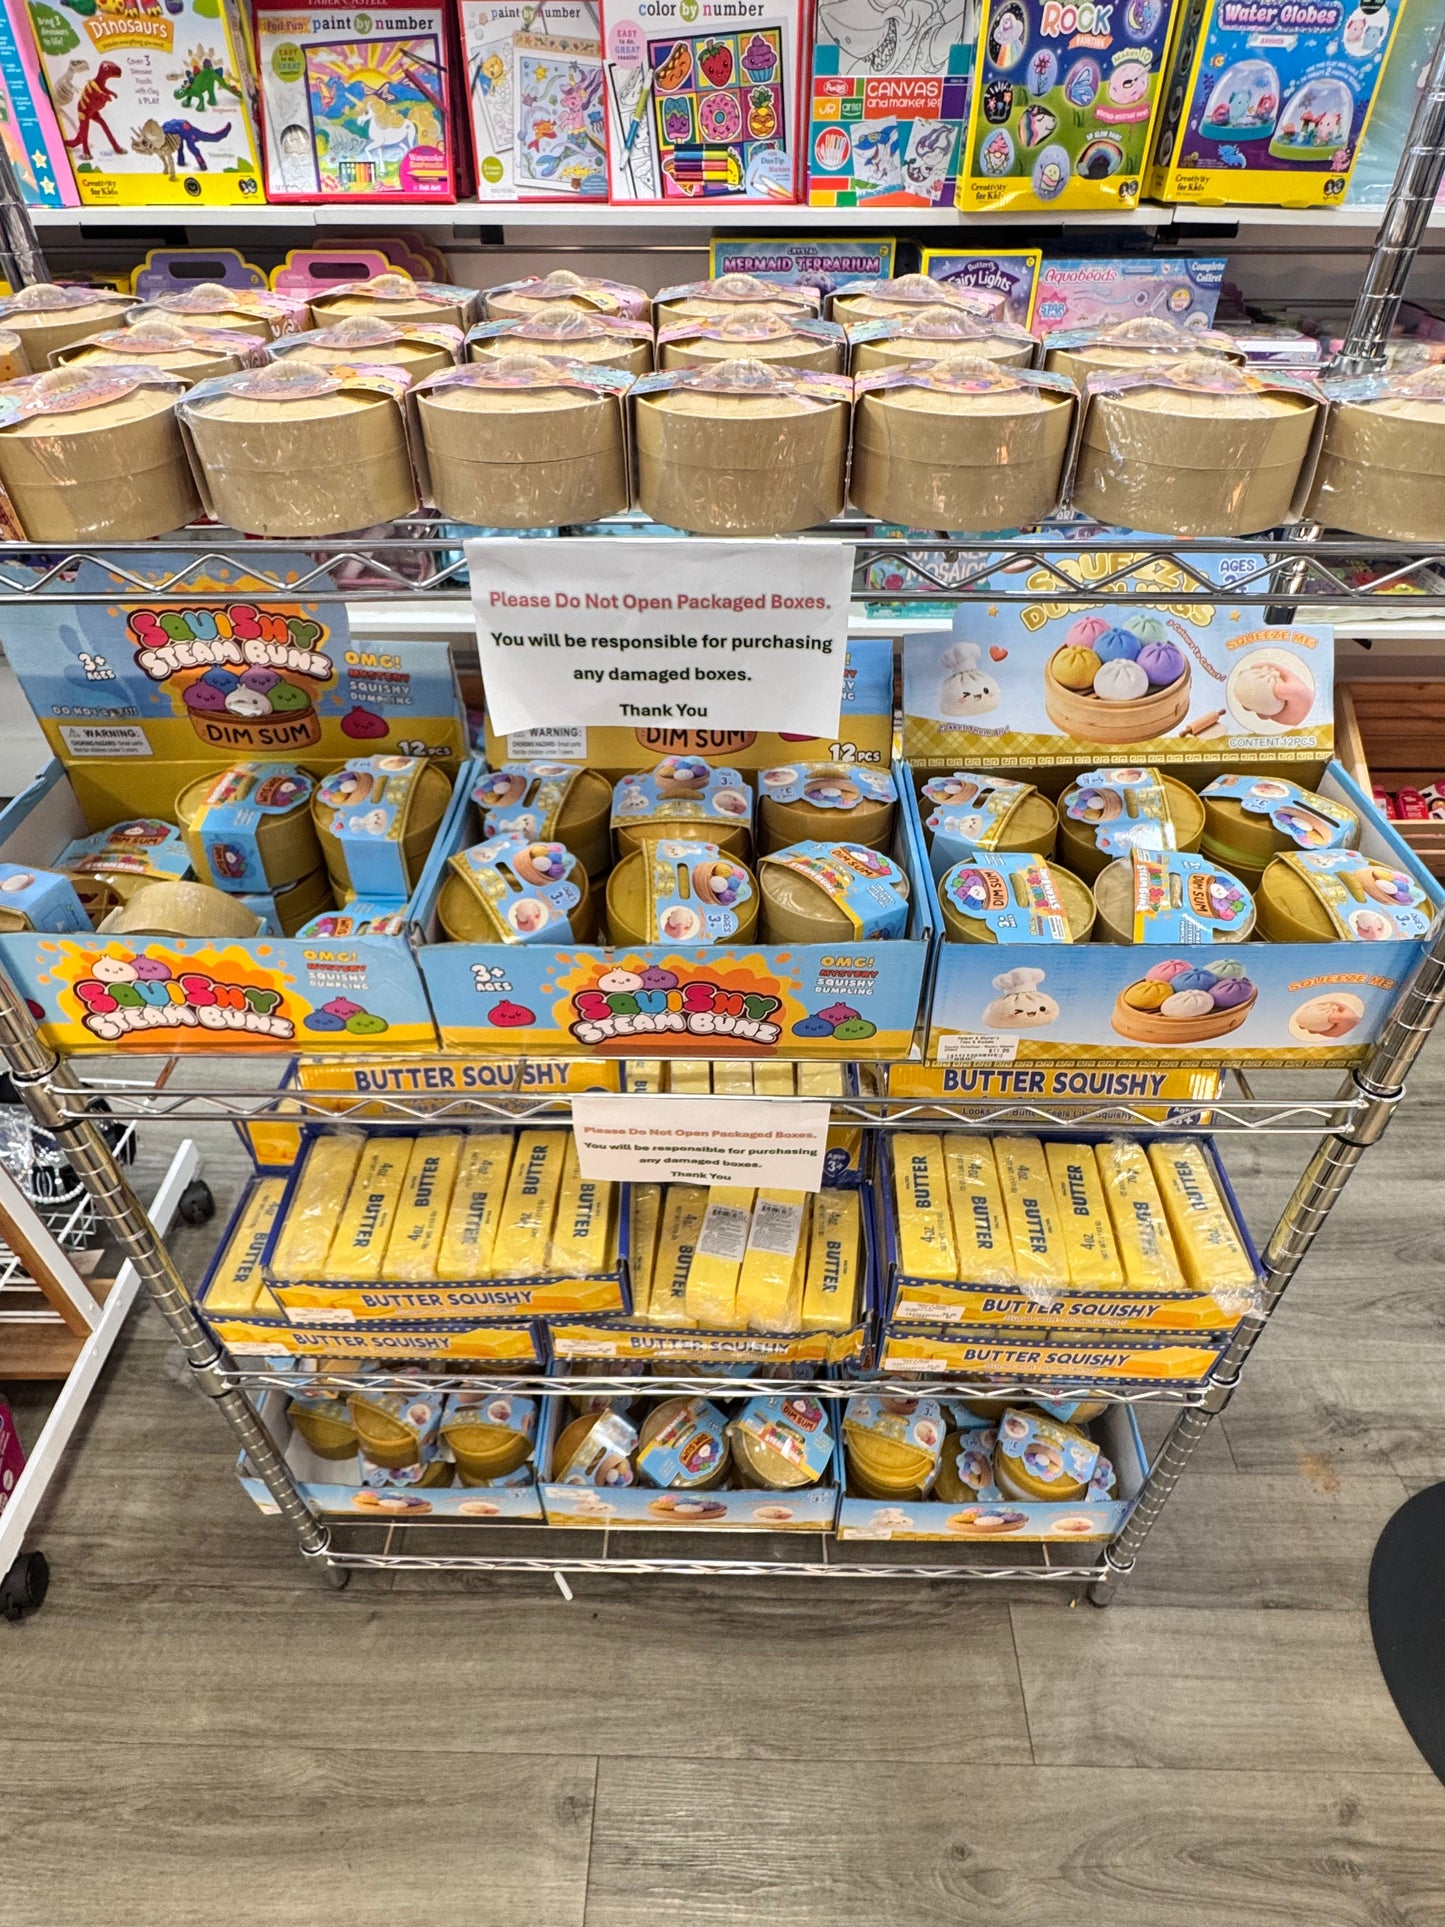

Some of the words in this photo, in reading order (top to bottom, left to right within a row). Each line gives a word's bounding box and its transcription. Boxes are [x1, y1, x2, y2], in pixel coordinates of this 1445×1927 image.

[491, 7, 519, 20] paint
[523, 9, 534, 19] by
[638, 1, 677, 16] color
[682, 1, 697, 18] by
[703, 1, 764, 16] number
[1225, 4, 1278, 22] Water
[1281, 6, 1337, 24] Globes
[89, 17, 168, 39] Dinosaurs
[312, 16, 351, 33] paint
[356, 14, 371, 32] by
[375, 16, 434, 30] number
[1041, 2, 1114, 37] ROCK
[617, 30, 637, 38] EASY
[615, 46, 640, 54] GREAT
[144, 55, 150, 66] 3
[867, 82, 938, 97] CANVAS
[819, 103, 836, 115] JR
[867, 99, 888, 108] and
[889, 98, 925, 108] marker
[82, 180, 116, 189] Creativity
[1175, 174, 1210, 184] Creativity
[971, 184, 1007, 193] Creativity
[787, 247, 818, 255] CRYSTAL
[724, 257, 793, 272] MERMAID
[796, 257, 880, 273] TERRARIUM
[967, 262, 996, 272] Butterfly
[1191, 261, 1225, 272] Complete
[978, 270, 1012, 292] Lights
[1044, 269, 1117, 283] Aquabeads
[1220, 558, 1256, 574] AGES
[489, 592, 550, 608] Please
[556, 593, 580, 608] Do
[586, 594, 619, 609] Not
[623, 594, 672, 613] Open
[678, 595, 765, 613] Packaged
[771, 595, 831, 610] Boxes.
[131, 604, 320, 649] SQUISHY
[491, 632, 524, 647] You
[529, 633, 560, 647] will
[565, 634, 587, 649] be
[591, 634, 697, 650] responsible
[702, 635, 727, 649] for
[731, 636, 832, 653] purchasing
[1226, 630, 1290, 651] SQUEEZE
[1292, 631, 1319, 649] ME!
[78, 652, 106, 671] 3+
[140, 640, 243, 680] STEAM
[244, 639, 332, 681] BUNZ
[344, 651, 401, 669] OMG!
[574, 669, 603, 682] any
[608, 667, 690, 683] damaged
[695, 668, 752, 682] boxes.
[350, 681, 410, 694] SQUISHY
[53, 706, 70, 715] DO
[75, 707, 97, 716] NOT
[619, 704, 672, 717] Thank
[677, 704, 708, 718] You
[83, 728, 140, 738] WARNING:
[206, 724, 254, 744] DIM
[260, 723, 311, 745] SUM
[529, 727, 582, 738] WARNING:
[646, 727, 689, 748] DIM
[694, 728, 745, 748] SUM
[397, 741, 427, 756] 12
[829, 742, 857, 761] 12
[857, 751, 881, 761] PCS
[986, 871, 1002, 890] SUM
[1195, 875, 1206, 892] DIM
[992, 889, 1005, 907] DIM
[1196, 892, 1208, 913] SUM
[303, 950, 358, 962] OMG!
[821, 956, 875, 968] OMG!
[308, 972, 366, 982] SQUISHY
[470, 964, 504, 983] 3+
[819, 969, 879, 978] MYSTERY
[309, 980, 369, 990] DUMPLING
[476, 981, 512, 992] AGES
[814, 986, 873, 995] DUMPLING
[817, 978, 875, 987] SQUISHY
[1287, 974, 1365, 993] SQUEEZE
[78, 976, 281, 1015] SQUISHY
[575, 983, 779, 1021] SQUISHY
[89, 1007, 198, 1039] STEAM
[197, 1006, 295, 1039] BUNZ
[574, 1013, 686, 1043] STEAM
[687, 1012, 781, 1044] BUNZ
[354, 1070, 455, 1092] BUTTER
[943, 1069, 1045, 1093] BUTTER
[1052, 1070, 1167, 1096] SQUISHY
[962, 1107, 990, 1116] Looks
[583, 1126, 625, 1136] Please
[629, 1128, 647, 1136] Do
[675, 1129, 709, 1139] Open
[712, 1130, 772, 1140] Packaged
[775, 1131, 817, 1139] Boxes.
[584, 1142, 608, 1151] You
[652, 1144, 725, 1154] responsible
[728, 1146, 746, 1155] for
[748, 1147, 818, 1157] purchasing
[827, 1152, 846, 1161] Ages
[522, 1145, 549, 1195] BUTTER
[639, 1157, 661, 1165] any
[664, 1158, 720, 1167] damaged
[722, 1160, 762, 1168] boxes.
[827, 1160, 844, 1172] 3+
[414, 1156, 440, 1207] BUTTER
[670, 1171, 707, 1180] Thank
[709, 1172, 732, 1181] You
[1016, 1164, 1030, 1182] 4oz
[912, 1155, 932, 1209] BUTTER
[1174, 1160, 1208, 1211] BUTTER
[572, 1183, 596, 1238] BUTTER
[1067, 1164, 1090, 1216] BUTTER
[1081, 1232, 1096, 1251] 4oz
[353, 1193, 385, 1248] BUTTER
[971, 1195, 994, 1250] BUTTER
[1022, 1197, 1048, 1255] BUTTER
[920, 1226, 936, 1243] 4oz
[822, 1240, 842, 1293] BUTTER
[361, 1294, 441, 1308] BUTTER
[446, 1290, 534, 1305] SQUISHY
[983, 1298, 1062, 1315] BUTTER
[1068, 1302, 1161, 1317] SQUISHY
[292, 1333, 367, 1348] BUTTER
[371, 1336, 451, 1350] SQUISHY
[630, 1336, 709, 1350] BUTTER
[964, 1349, 1041, 1364] BUTTER
[1044, 1352, 1131, 1367] SQUISHY
